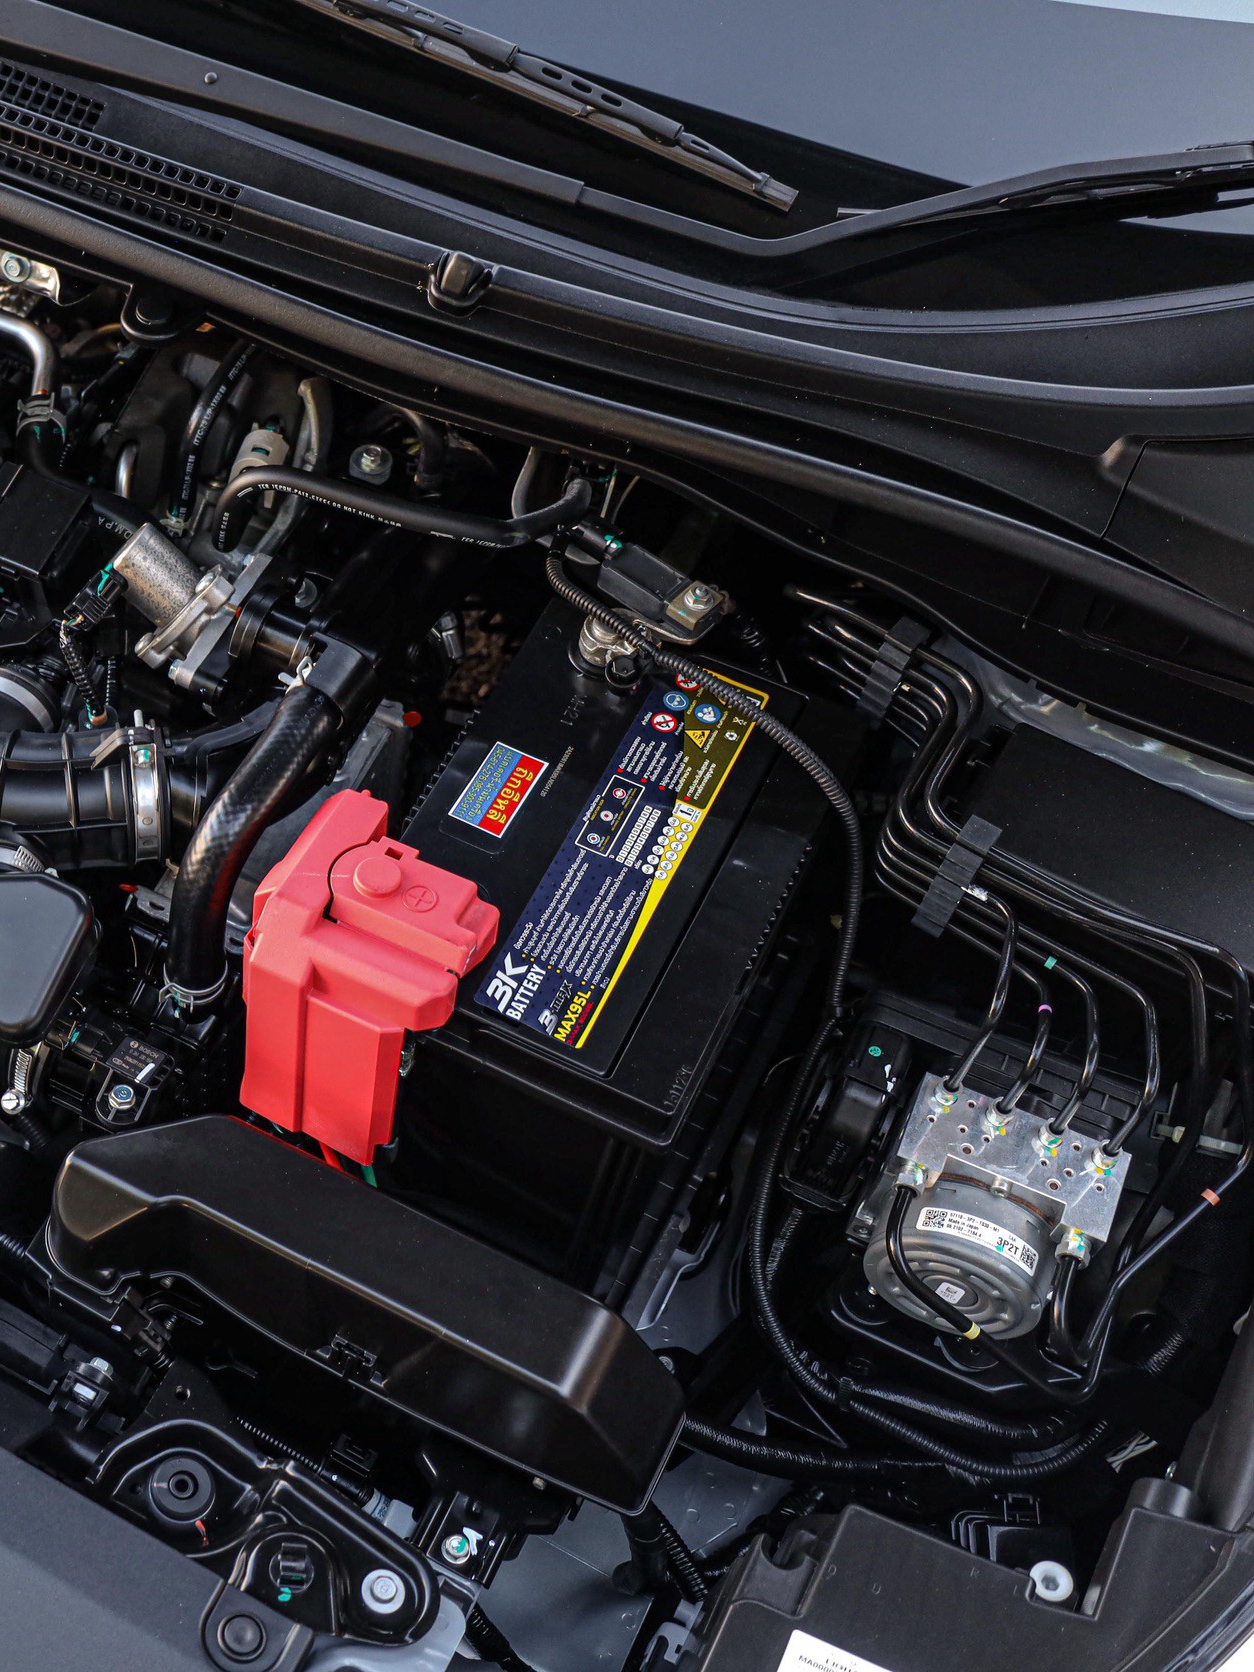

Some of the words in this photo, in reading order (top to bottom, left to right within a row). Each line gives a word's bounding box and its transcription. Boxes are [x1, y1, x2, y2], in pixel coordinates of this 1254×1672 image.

[486, 952, 529, 1013] 3K
[506, 964, 546, 1021] BATTERY
[554, 989, 592, 1042] MAX95L
[139, 1045, 159, 1059] BOSCH
[996, 1236, 1020, 1256] 3P2T
